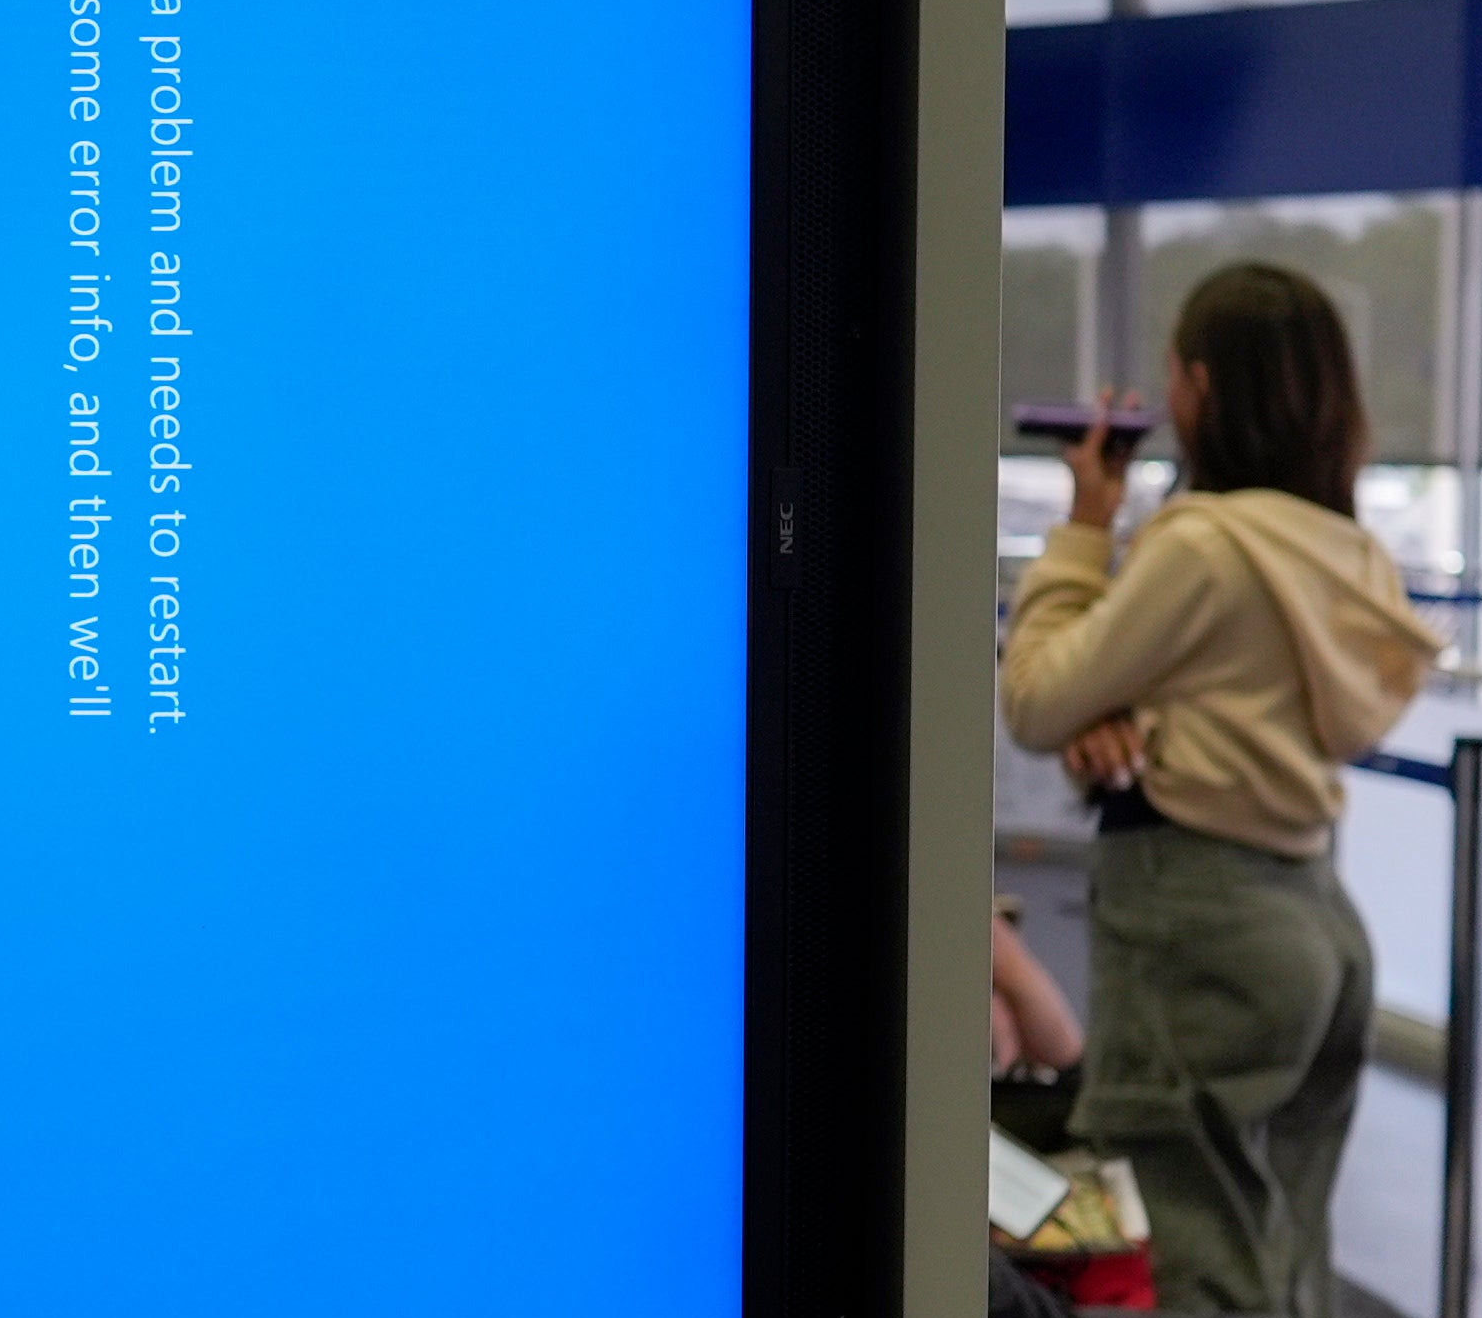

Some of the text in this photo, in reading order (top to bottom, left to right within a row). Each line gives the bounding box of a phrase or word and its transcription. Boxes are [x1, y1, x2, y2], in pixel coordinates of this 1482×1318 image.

[138, 36, 194, 232] problem
[69, 140, 101, 257] error
[62, 274, 114, 373] info,
[149, 251, 194, 336] and
[69, 392, 113, 476] and
[149, 356, 193, 494] needs
[68, 495, 113, 598] then
[149, 510, 187, 558] to
[779, 502, 795, 555] NEC
[68, 616, 112, 718] we'll
[149, 576, 187, 738] restart.
